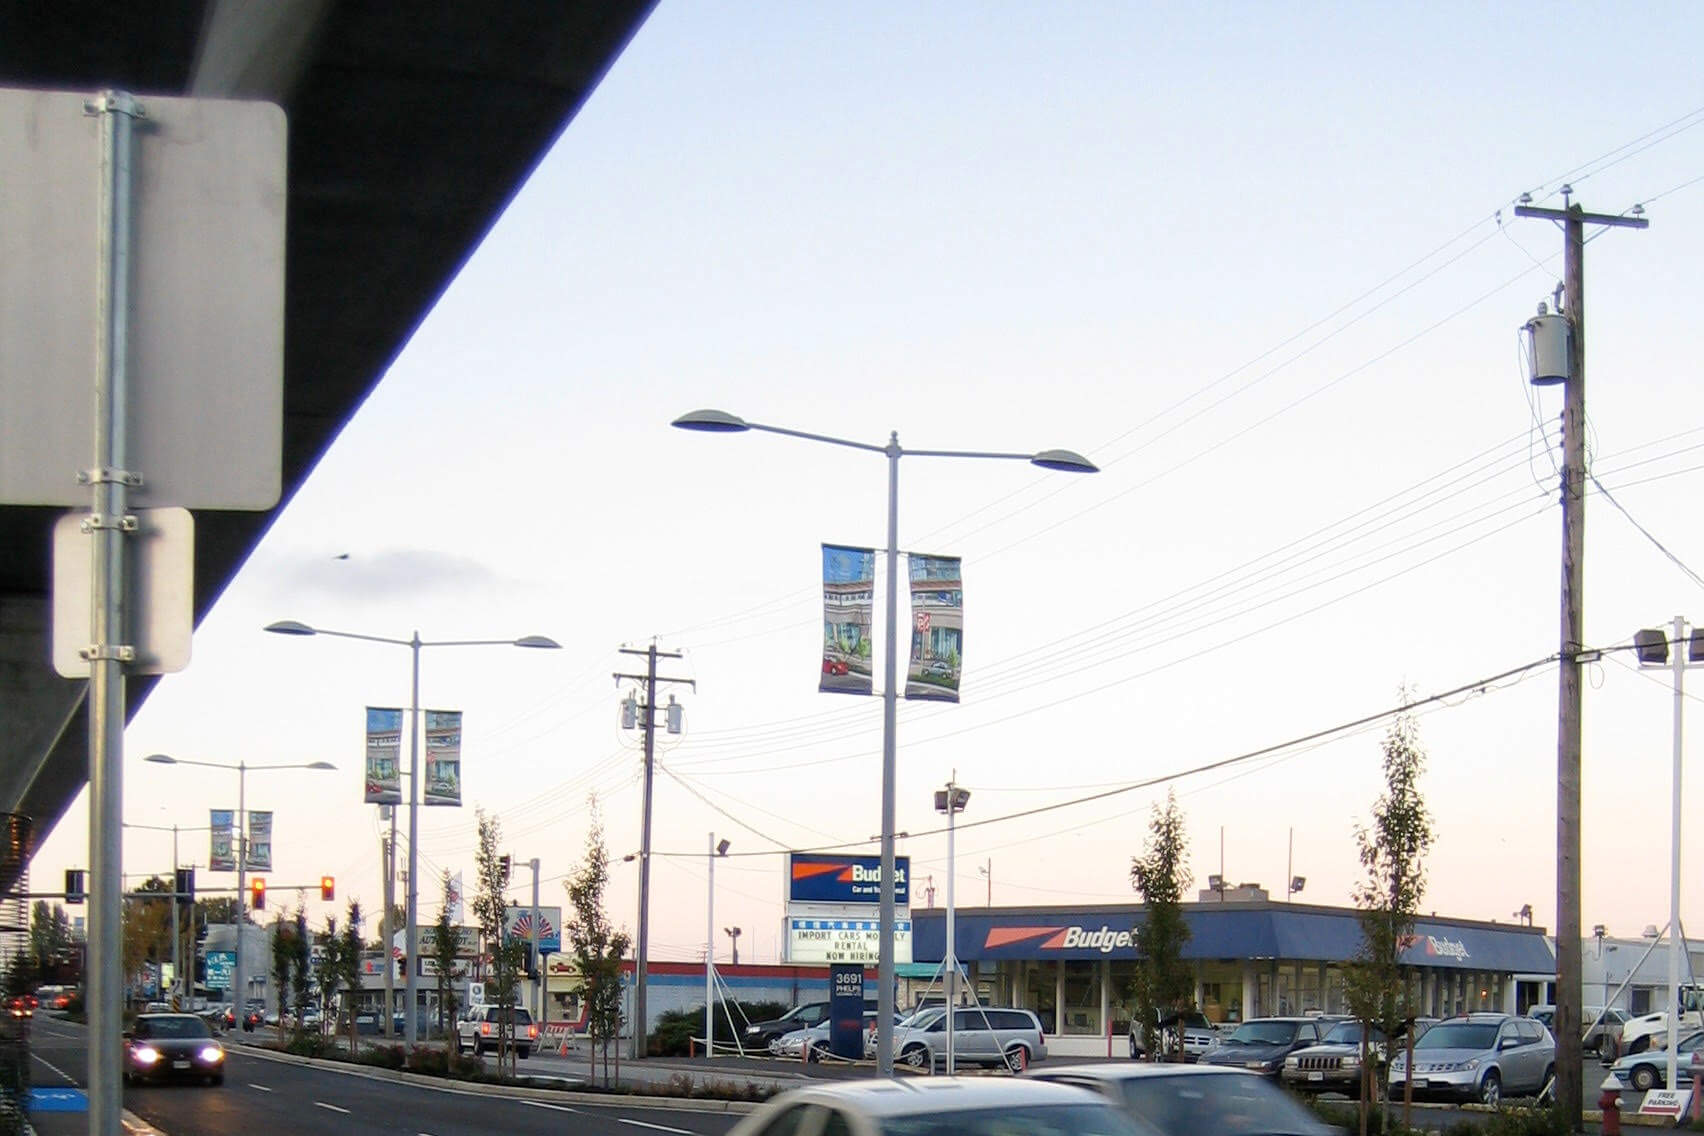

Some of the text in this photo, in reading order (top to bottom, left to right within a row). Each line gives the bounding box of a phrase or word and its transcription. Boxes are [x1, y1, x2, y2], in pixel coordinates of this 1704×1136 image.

[852, 865, 906, 883] Budet
[798, 931, 905, 941] IMPORT CARS MOLY
[834, 942, 868, 951] RENTAL
[1427, 935, 1471, 961] Budget
[826, 952, 880, 961] NOW HIRING
[836, 973, 862, 984] 3691
